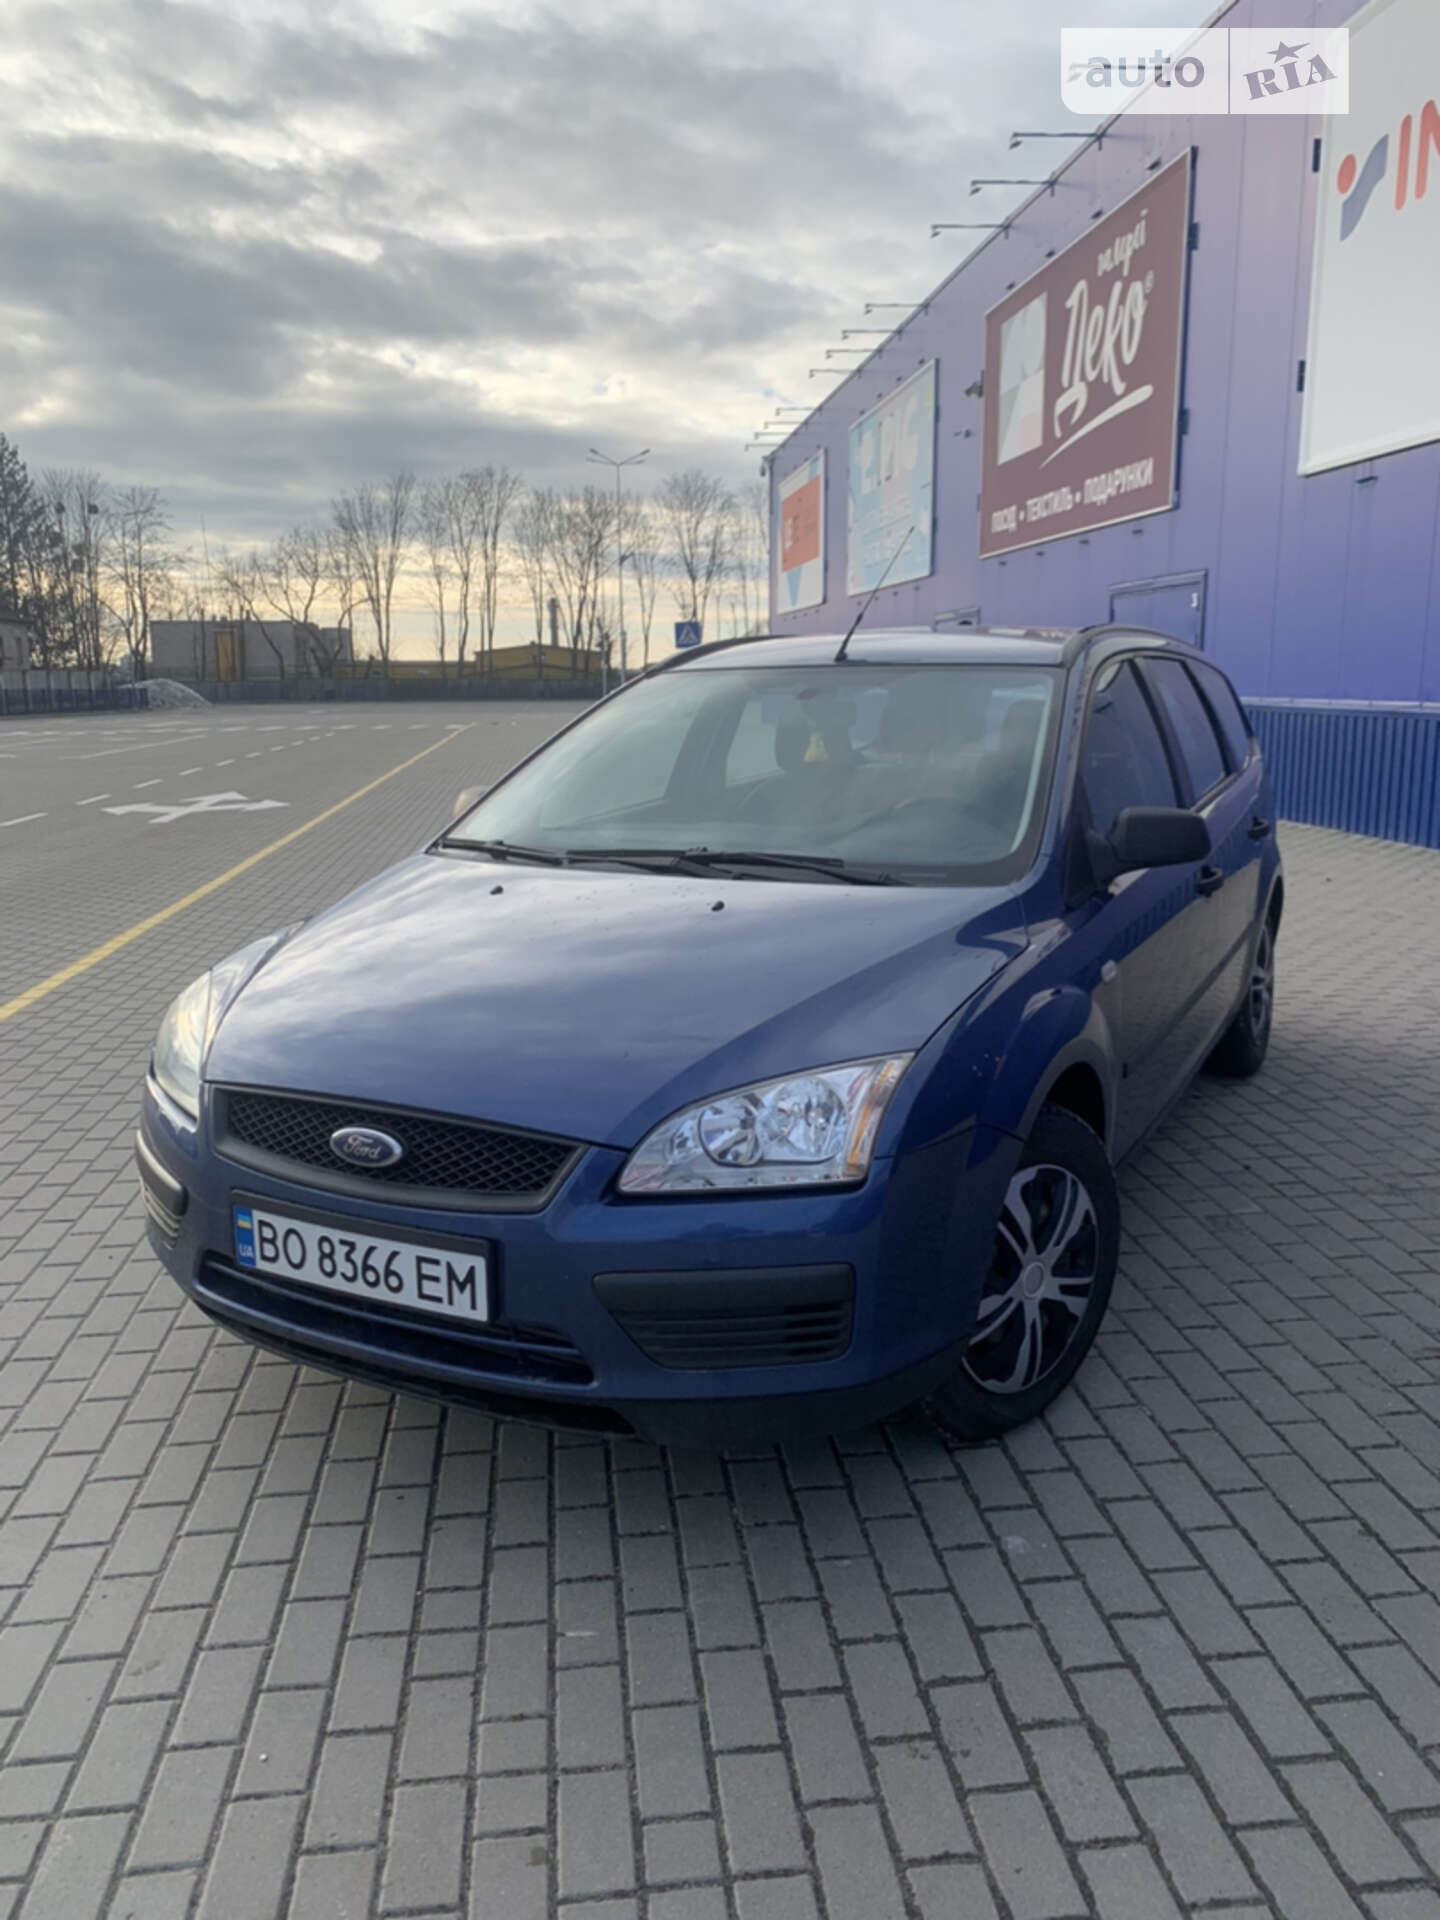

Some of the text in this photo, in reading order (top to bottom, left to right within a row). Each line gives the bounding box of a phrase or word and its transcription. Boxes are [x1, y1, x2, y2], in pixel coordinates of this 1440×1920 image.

[1083, 457, 1154, 506] ПОДАРУНКИ
[343, 1134, 383, 1159] Ford
[257, 1219, 478, 1311] BO 8366 EM
